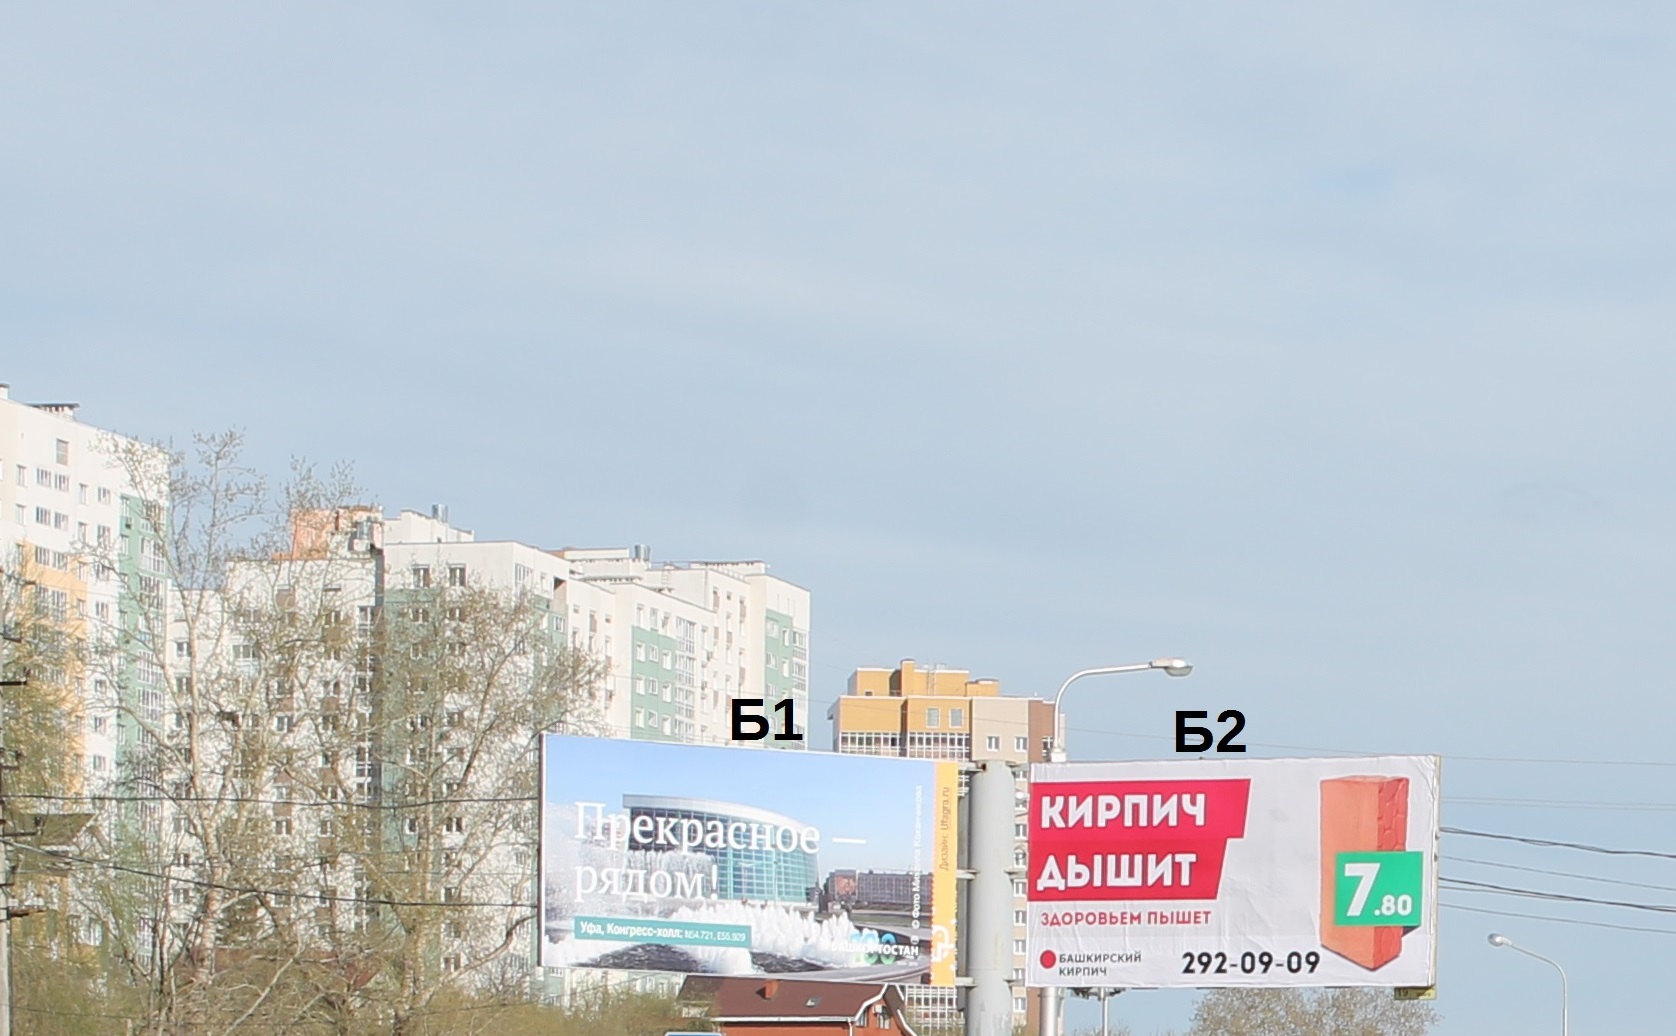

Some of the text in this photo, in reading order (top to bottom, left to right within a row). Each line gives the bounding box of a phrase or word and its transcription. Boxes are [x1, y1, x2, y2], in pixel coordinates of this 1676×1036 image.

[1041, 794, 1206, 828] КИРПИЧ
[574, 801, 821, 855] Прекрасное
[574, 864, 719, 904] рядом!
[1036, 853, 1198, 891] ДЫШИТ
[1344, 862, 1412, 917] 7.80
[580, 921, 605, 936] Уфа,
[1040, 910, 1212, 927] ЗДОРОВЬЕМ ПЫШЕТ
[1059, 951, 1142, 964] БАШКИРСКИЙ
[1059, 966, 1107, 977] КИРПИЧ
[1181, 950, 1321, 974] 292-09-09
